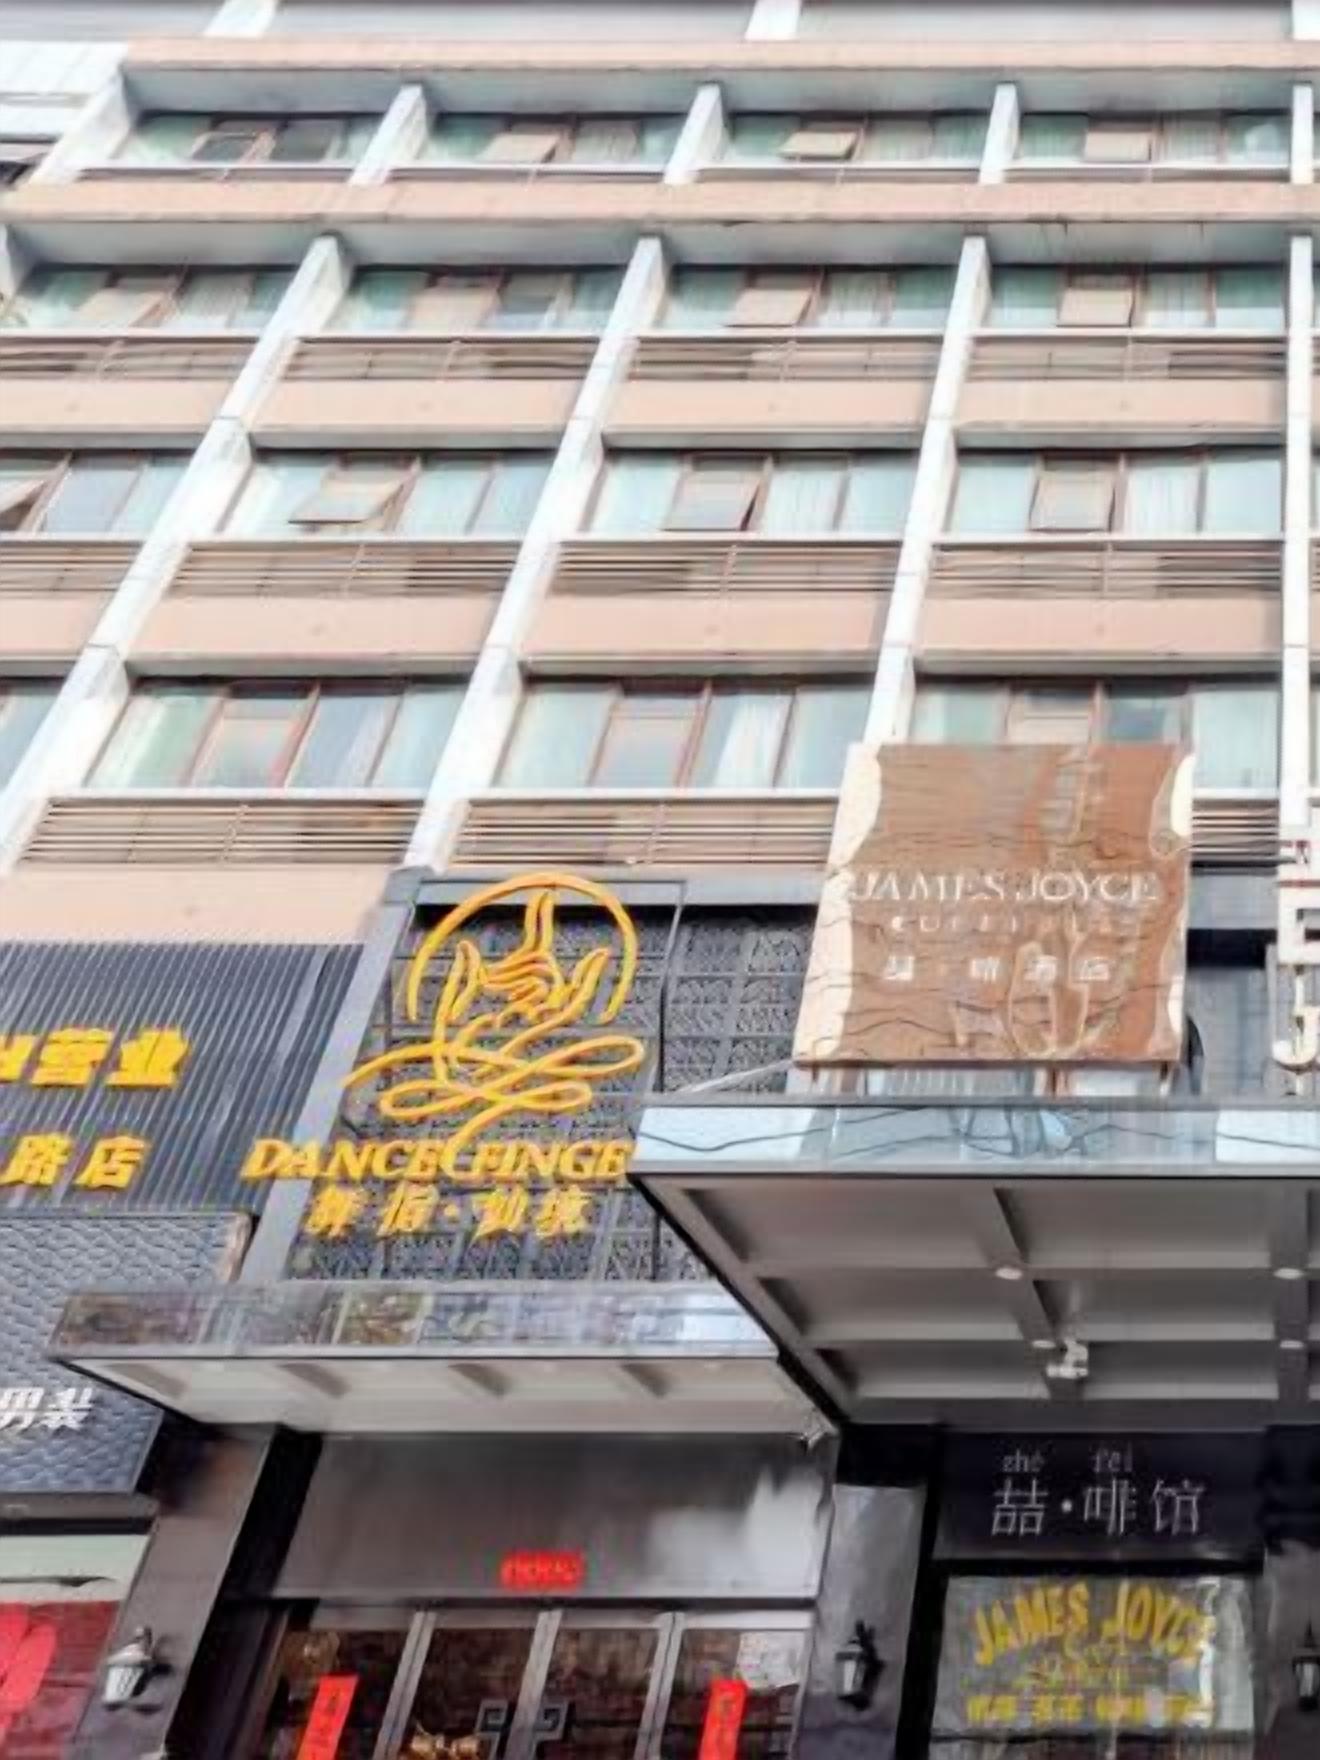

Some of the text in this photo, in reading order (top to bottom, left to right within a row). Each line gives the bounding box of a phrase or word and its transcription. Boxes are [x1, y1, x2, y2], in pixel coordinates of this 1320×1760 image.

[1016, 870, 1158, 901] JOYCE
[241, 1138, 440, 1180] DANCE
[974, 1580, 1091, 1666] JAMES
